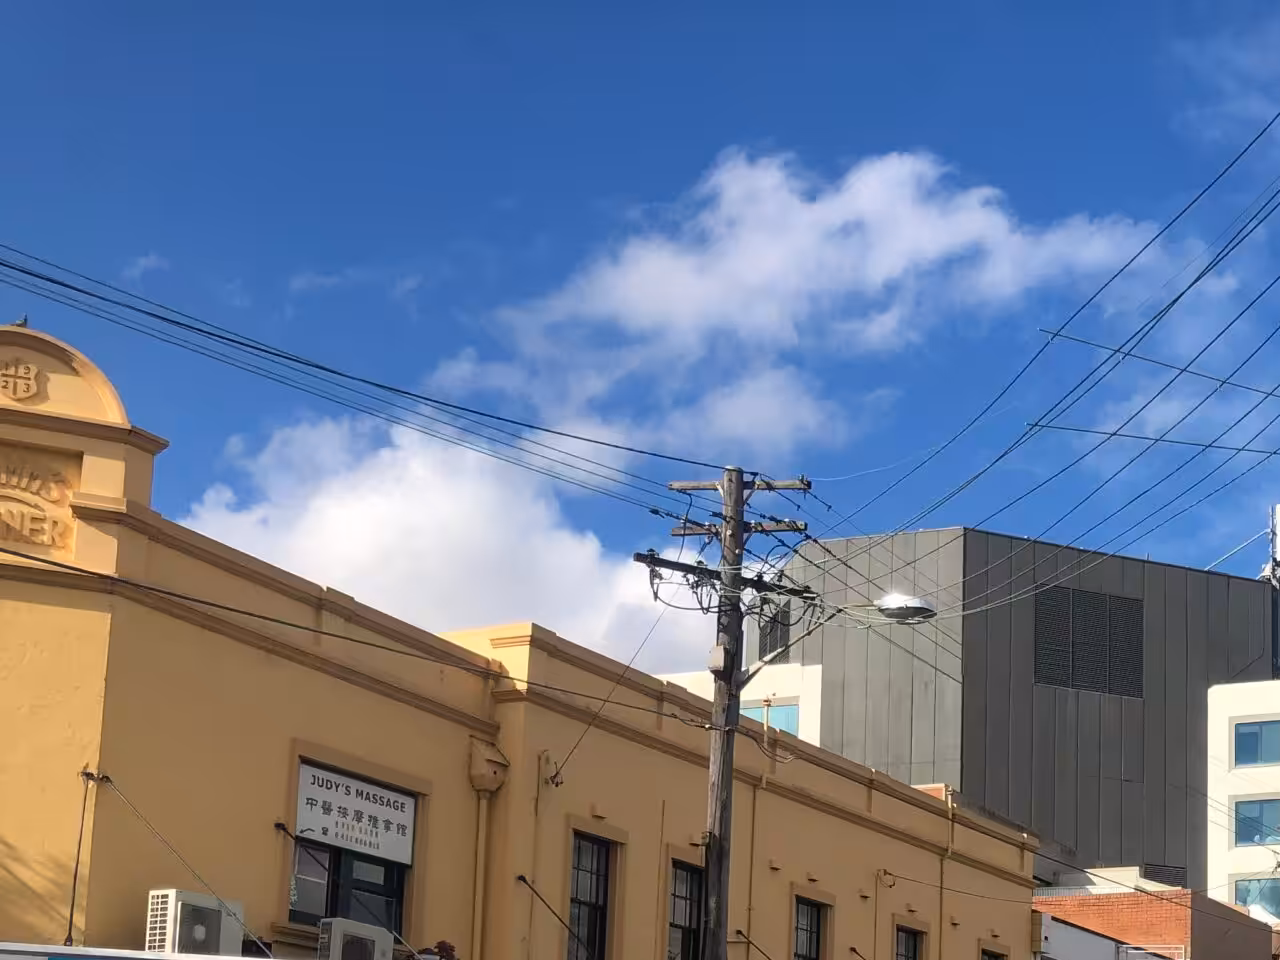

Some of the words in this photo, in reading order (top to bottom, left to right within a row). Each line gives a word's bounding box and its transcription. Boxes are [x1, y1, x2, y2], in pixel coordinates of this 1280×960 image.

[0, 506, 67, 548] NER
[310, 774, 352, 796] JUDY'S
[355, 788, 407, 813] MASSAGE
